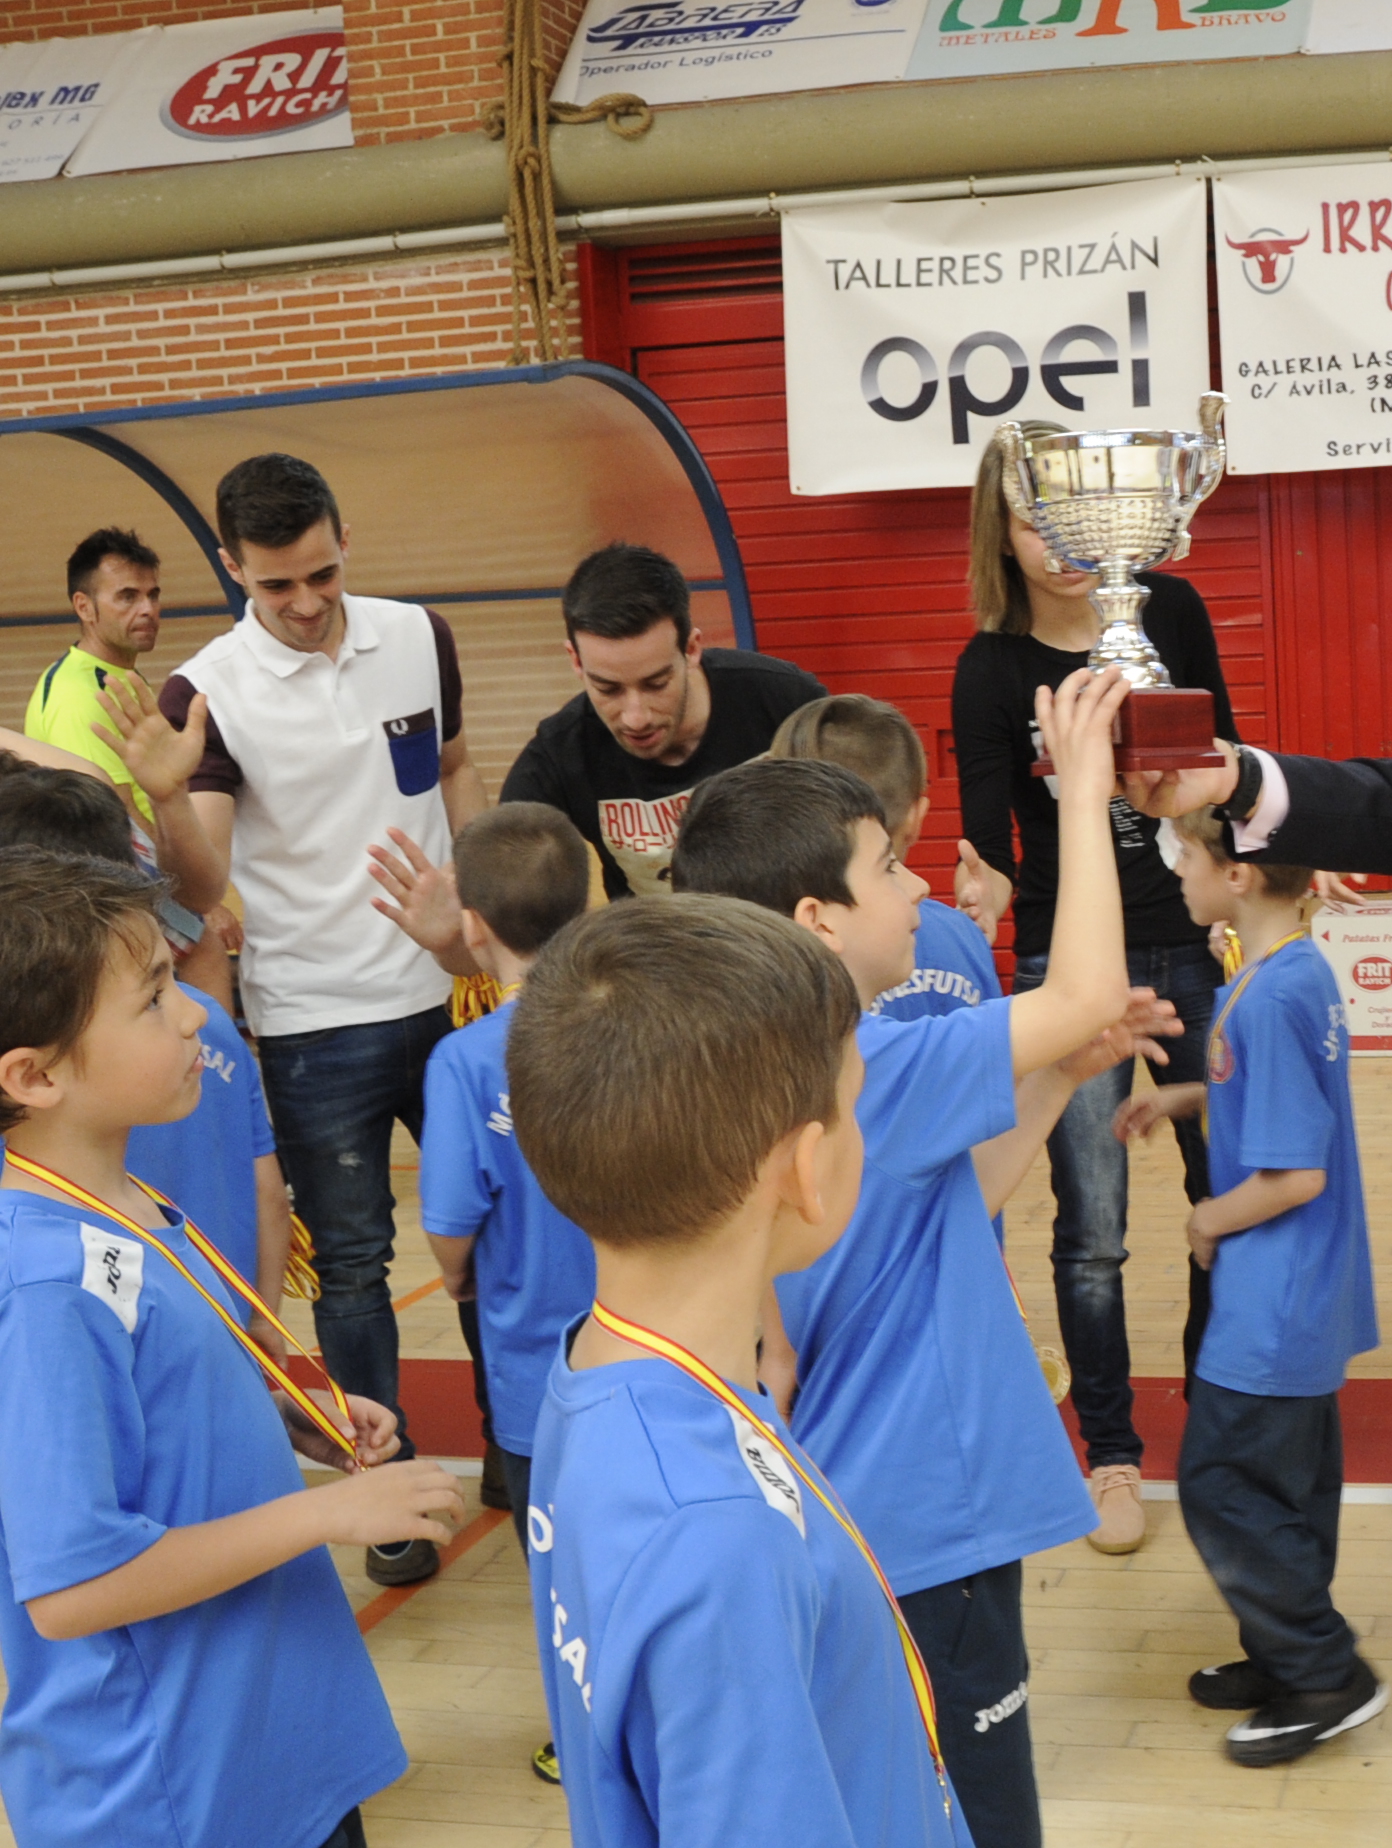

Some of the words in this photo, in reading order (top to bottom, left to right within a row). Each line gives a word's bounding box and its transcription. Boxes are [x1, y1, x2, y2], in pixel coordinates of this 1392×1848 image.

[939, 28, 1057, 47] METALES
[1200, 11, 1287, 27] BRAVO
[679, 49, 773, 66] Logístico
[0, 91, 46, 110] lex
[49, 83, 101, 106] MG
[187, 89, 344, 126] RAVICH
[826, 251, 1003, 291] TALLERES
[1020, 231, 1160, 281] PRIZÁN
[861, 290, 1151, 445] opel
[1238, 354, 1343, 378] GALERIA
[1251, 382, 1278, 399] C/
[1288, 378, 1355, 397] Ávila,
[1357, 962, 1392, 977] FRIT
[1358, 977, 1391, 985] RAVICH
